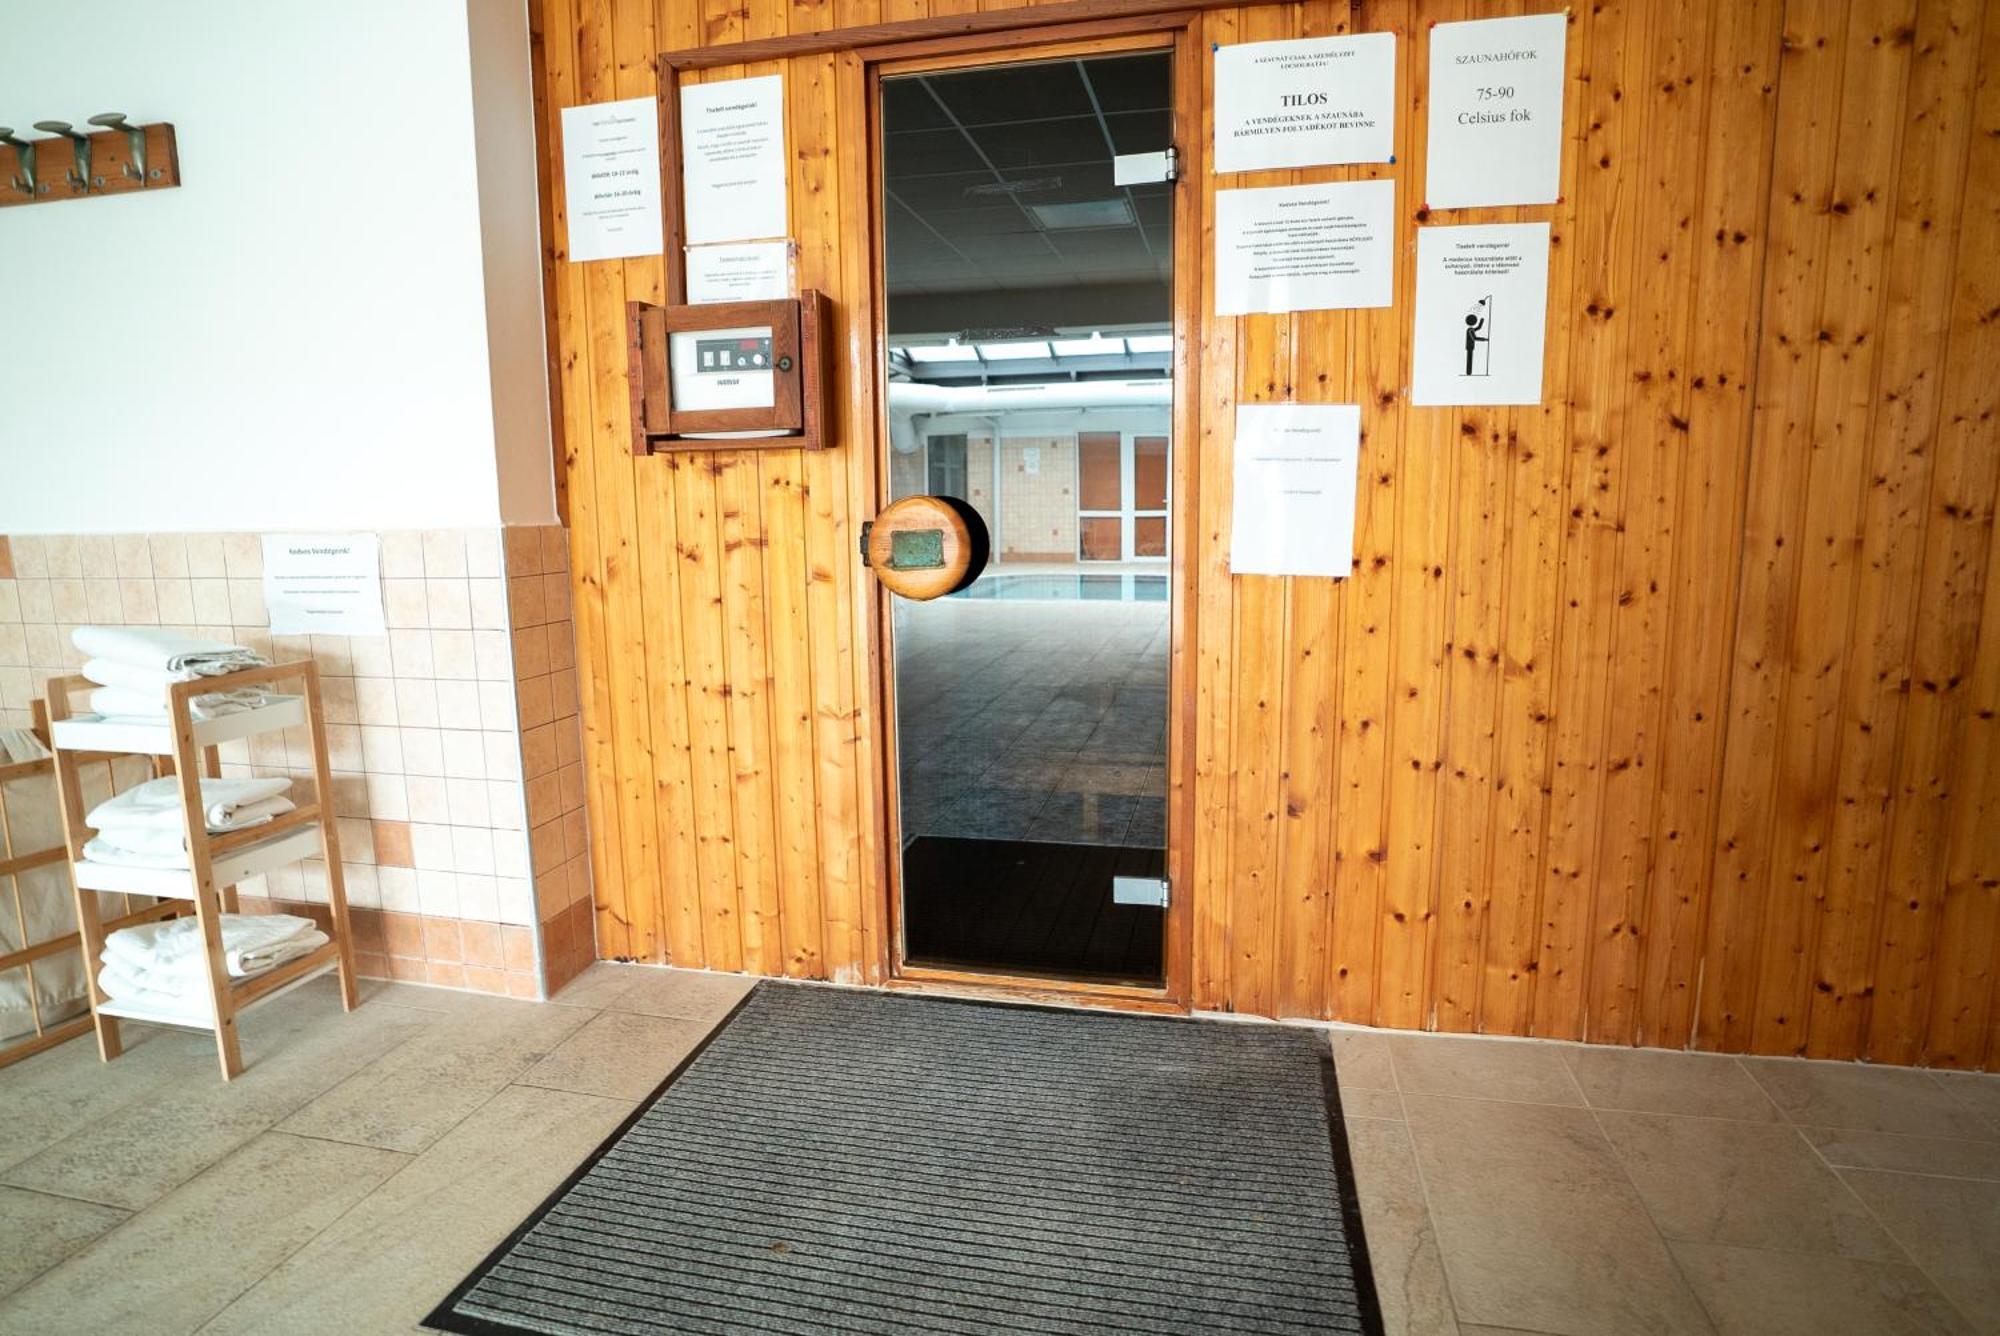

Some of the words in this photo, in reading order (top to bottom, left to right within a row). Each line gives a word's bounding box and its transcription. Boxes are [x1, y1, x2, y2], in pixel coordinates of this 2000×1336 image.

[1281, 92, 1328, 107] TILOS
[1477, 86, 1514, 102] 75-90
[1252, 114, 1312, 125] VENDÉGEKNEK
[1321, 110, 1364, 121] SZAUNÁBA
[1458, 110, 1506, 124] Celsius
[1510, 108, 1531, 122] fok
[1233, 126, 1281, 137] BÁRMILYEN
[1282, 122, 1337, 134] FOLYADÉKOT
